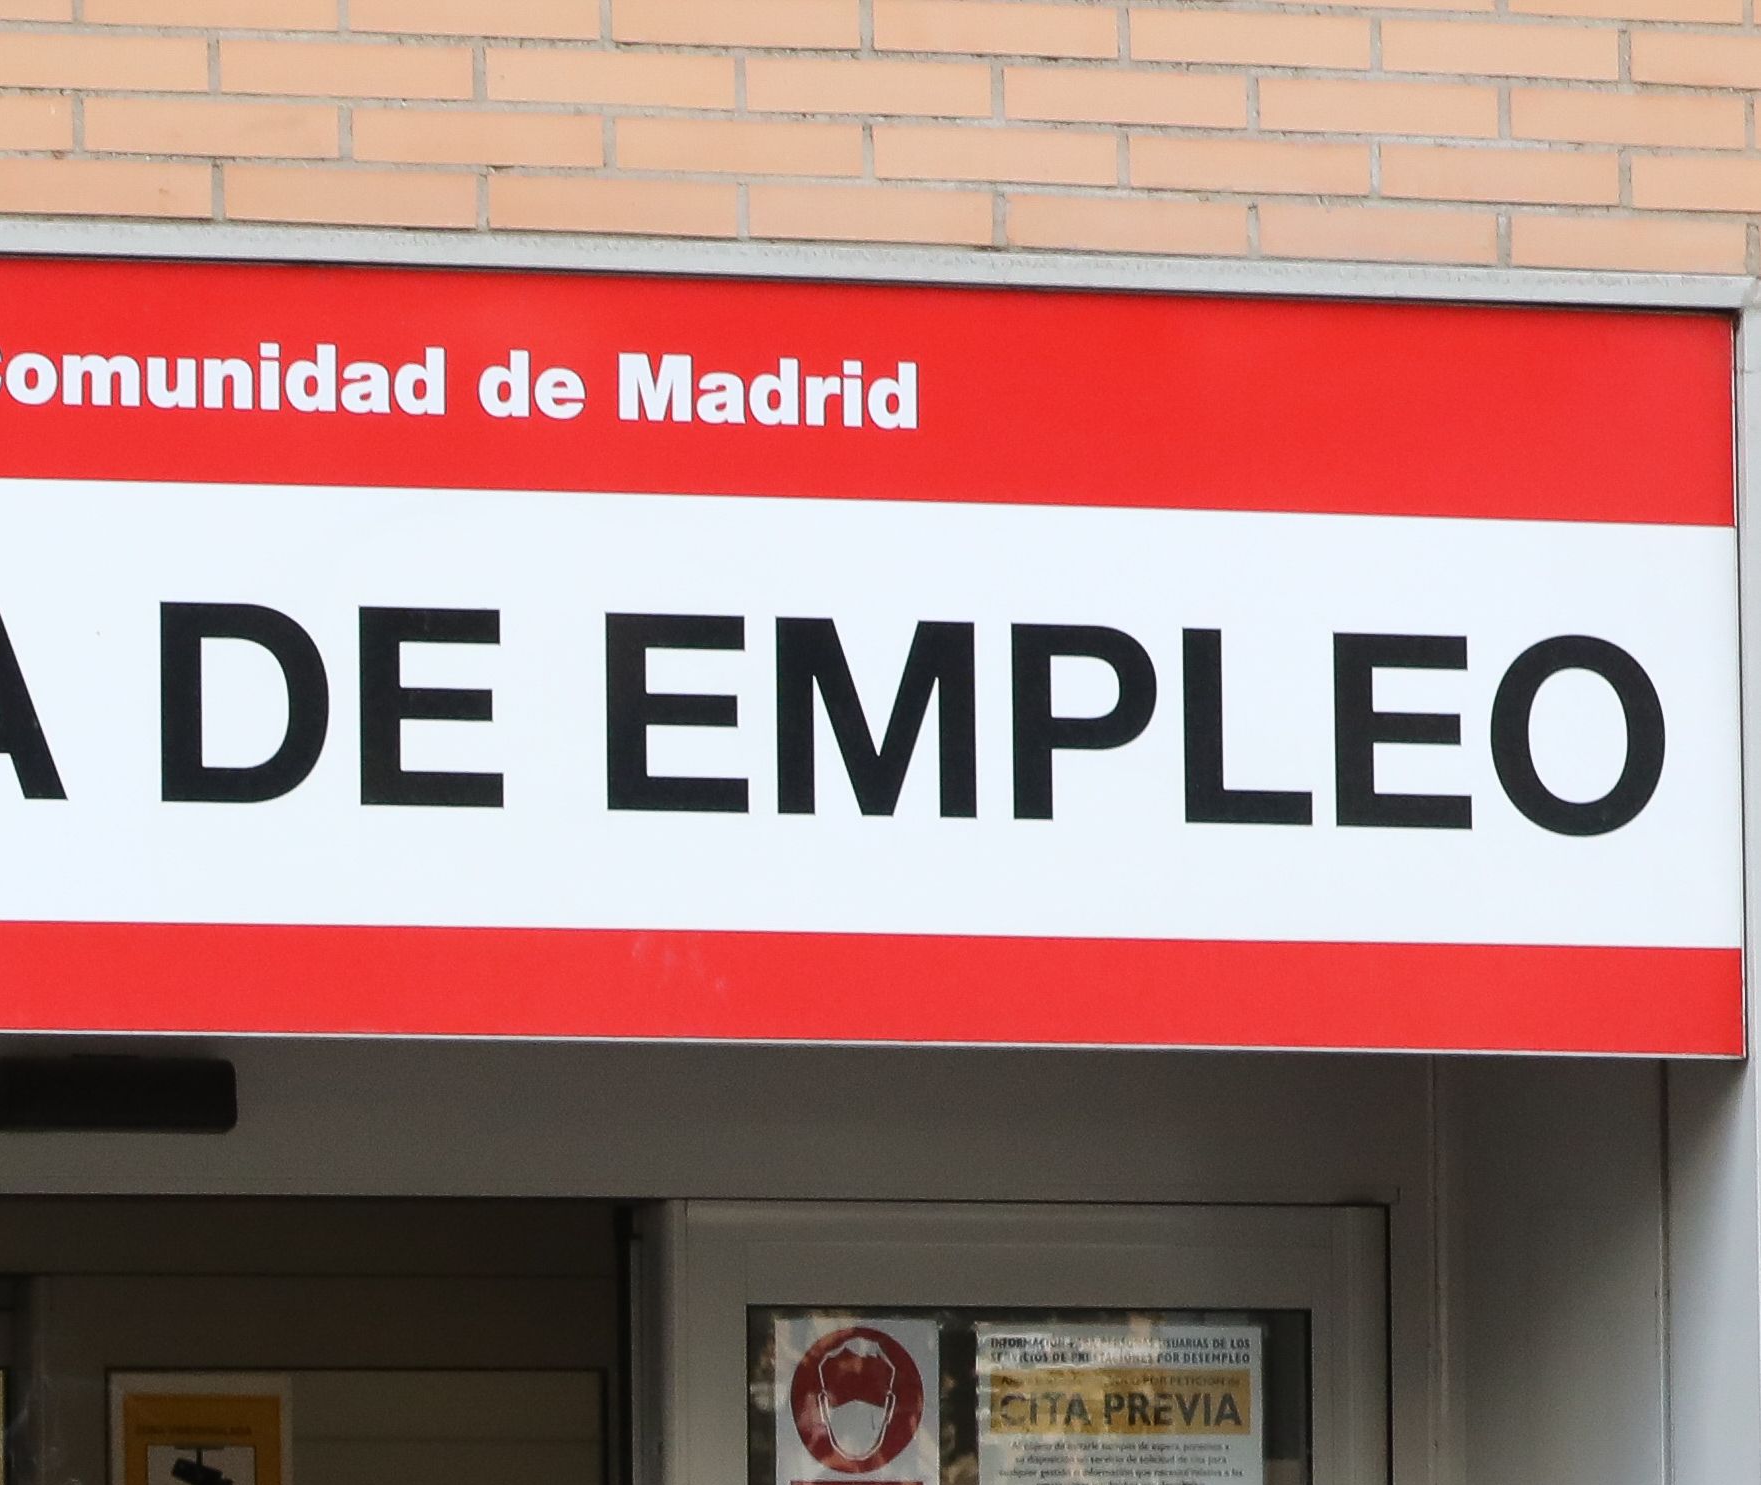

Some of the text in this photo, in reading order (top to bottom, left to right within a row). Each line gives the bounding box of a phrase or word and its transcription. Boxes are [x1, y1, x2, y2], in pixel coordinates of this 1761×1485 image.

[479, 350, 585, 418] de
[619, 353, 917, 428] Madrid
[161, 602, 503, 807] DE
[606, 614, 1665, 836] EMPLEO
[1183, 1353, 1250, 1364] DESEMPLEO
[1213, 1337, 1226, 1349] DE
[1230, 1337, 1250, 1349] LOS
[1000, 1391, 1242, 1427] CITA PREVIA
